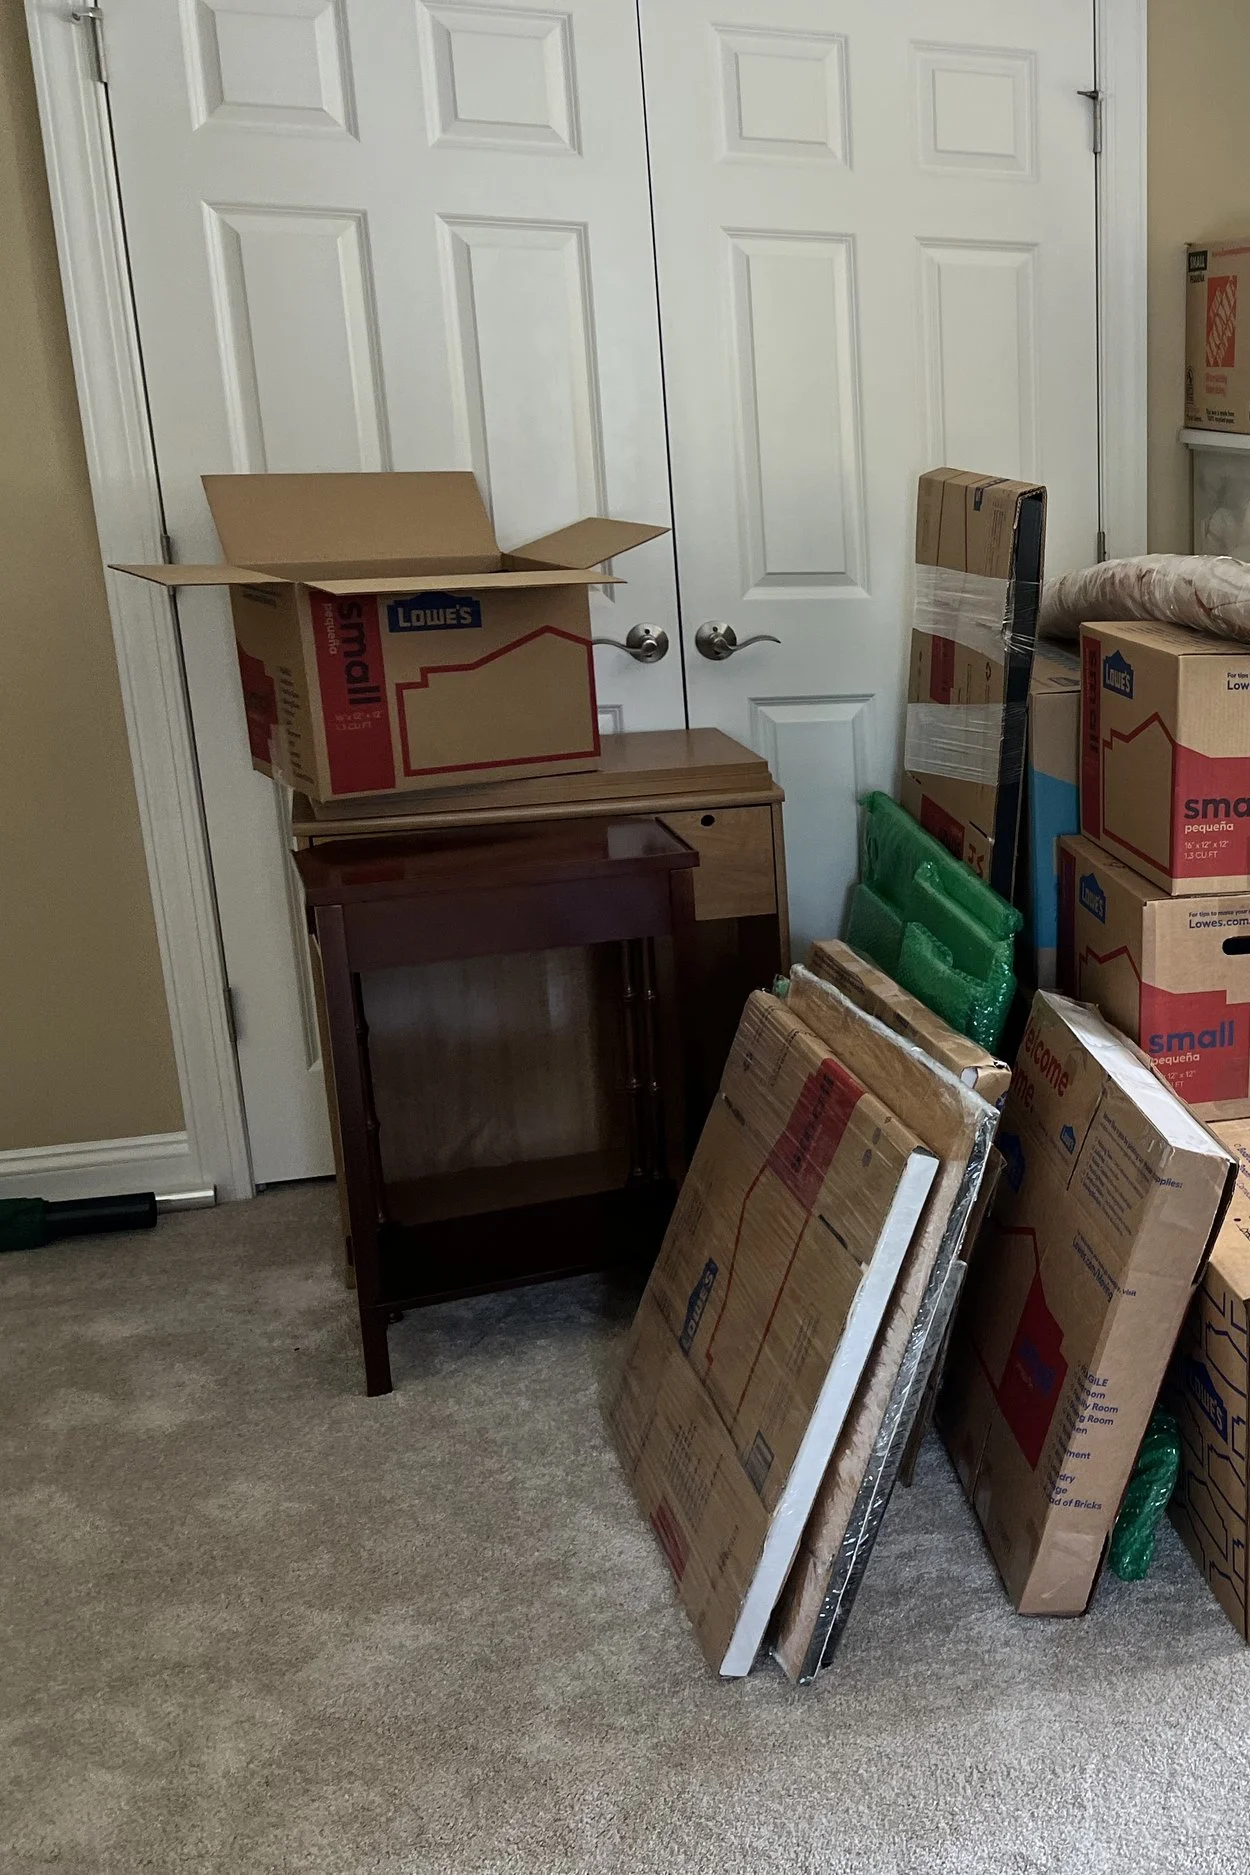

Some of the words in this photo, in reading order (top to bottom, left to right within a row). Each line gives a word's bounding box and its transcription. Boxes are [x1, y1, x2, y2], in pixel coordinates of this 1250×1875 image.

[397, 603, 472, 627] LOWE'S
[338, 600, 381, 705] small
[1185, 821, 1234, 834] pequeña
[1149, 1019, 1234, 1055] small
[1150, 1052, 1200, 1065] pequeña
[1092, 1402, 1118, 1414] Room
[1087, 1414, 1114, 1426] Room
[1063, 1499, 1073, 1508] of
[1074, 1499, 1102, 1510] Bricks
